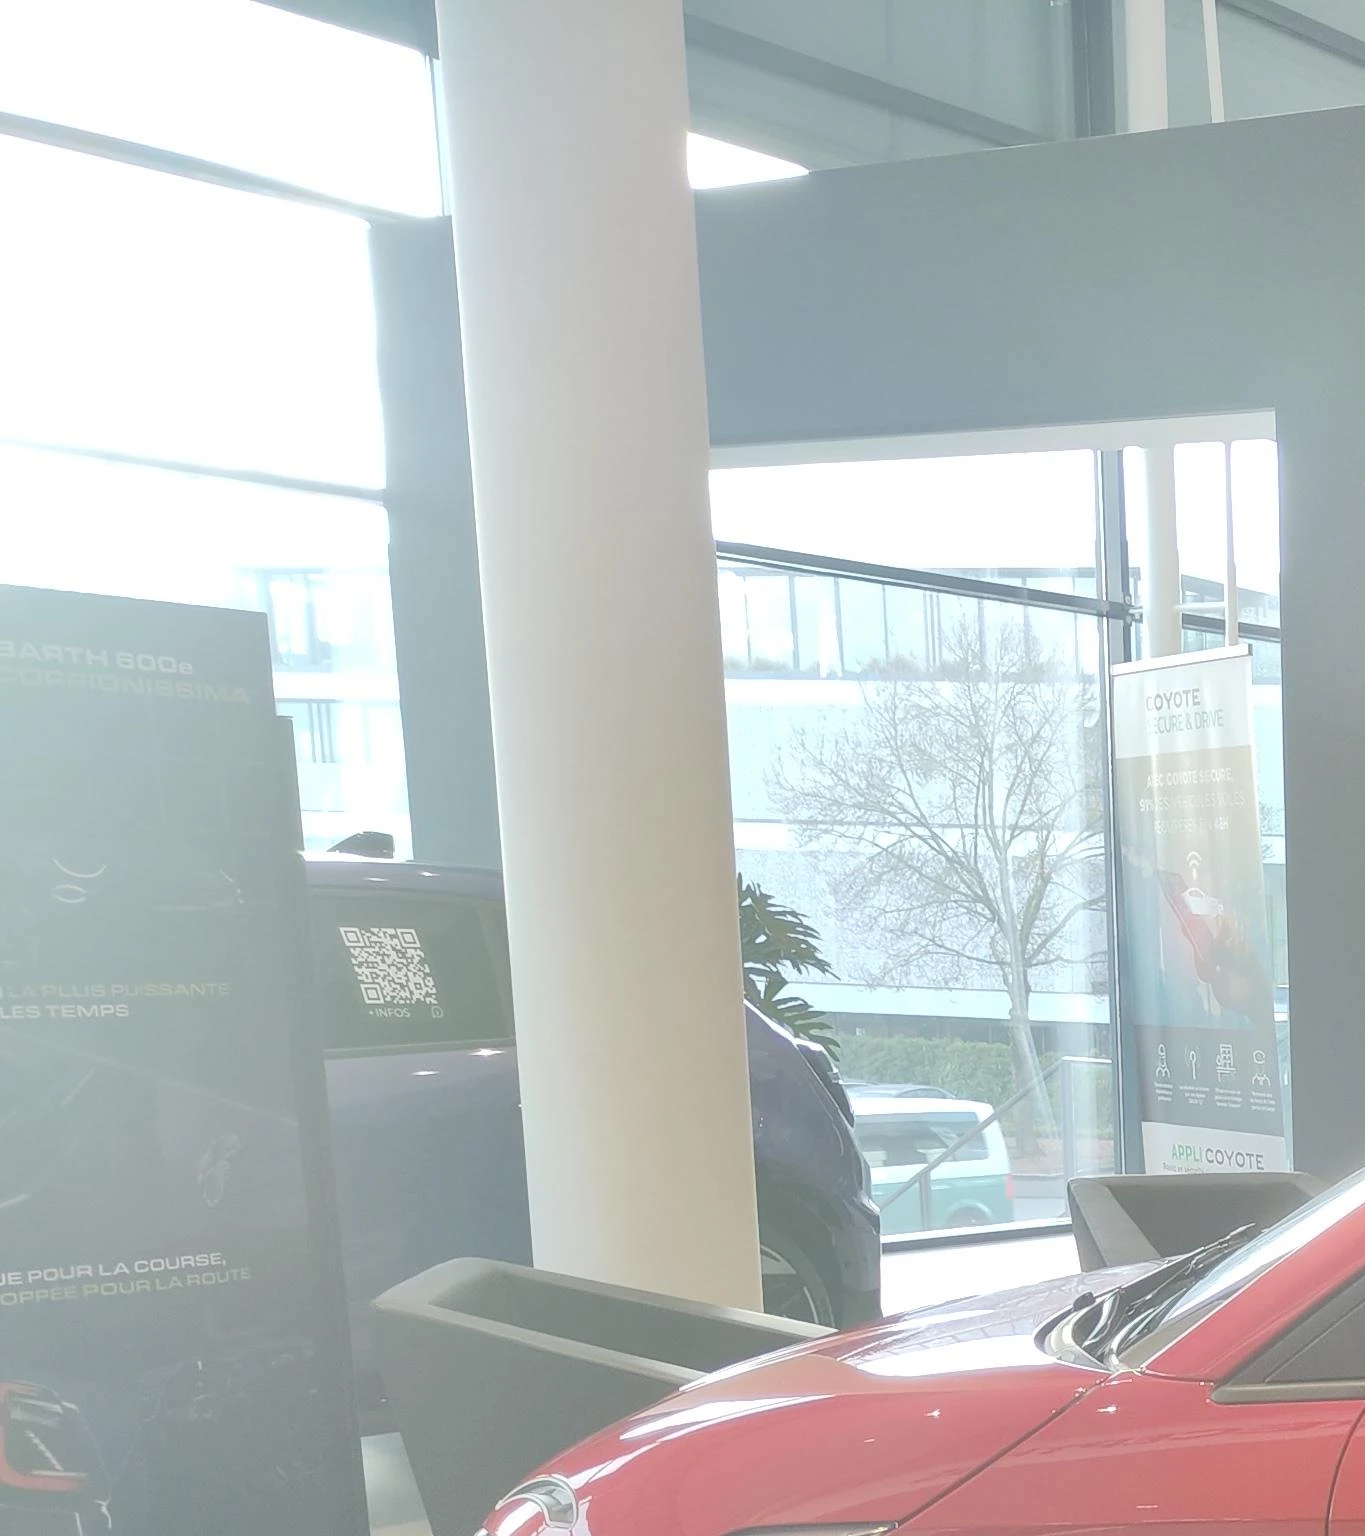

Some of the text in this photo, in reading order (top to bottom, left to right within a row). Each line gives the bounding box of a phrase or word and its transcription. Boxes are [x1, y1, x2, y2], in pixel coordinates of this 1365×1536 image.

[115, 652, 193, 675] 600e
[1146, 688, 1200, 711] COYOTE
[1147, 714, 1183, 734] ECURE
[41, 983, 105, 998] PLUS
[111, 981, 229, 997] PUISSANTE
[44, 1003, 129, 1018] TEMPS
[375, 1007, 411, 1019] INFOS
[1172, 1144, 1202, 1162] APPLI
[1205, 1148, 1265, 1171] COYOTE
[27, 1264, 92, 1283] POUR
[98, 1259, 129, 1276] LA
[134, 1252, 227, 1273] COURSE,
[82, 1279, 150, 1297] POUR
[155, 1274, 183, 1291] LA
[186, 1267, 252, 1286] ROUTE
